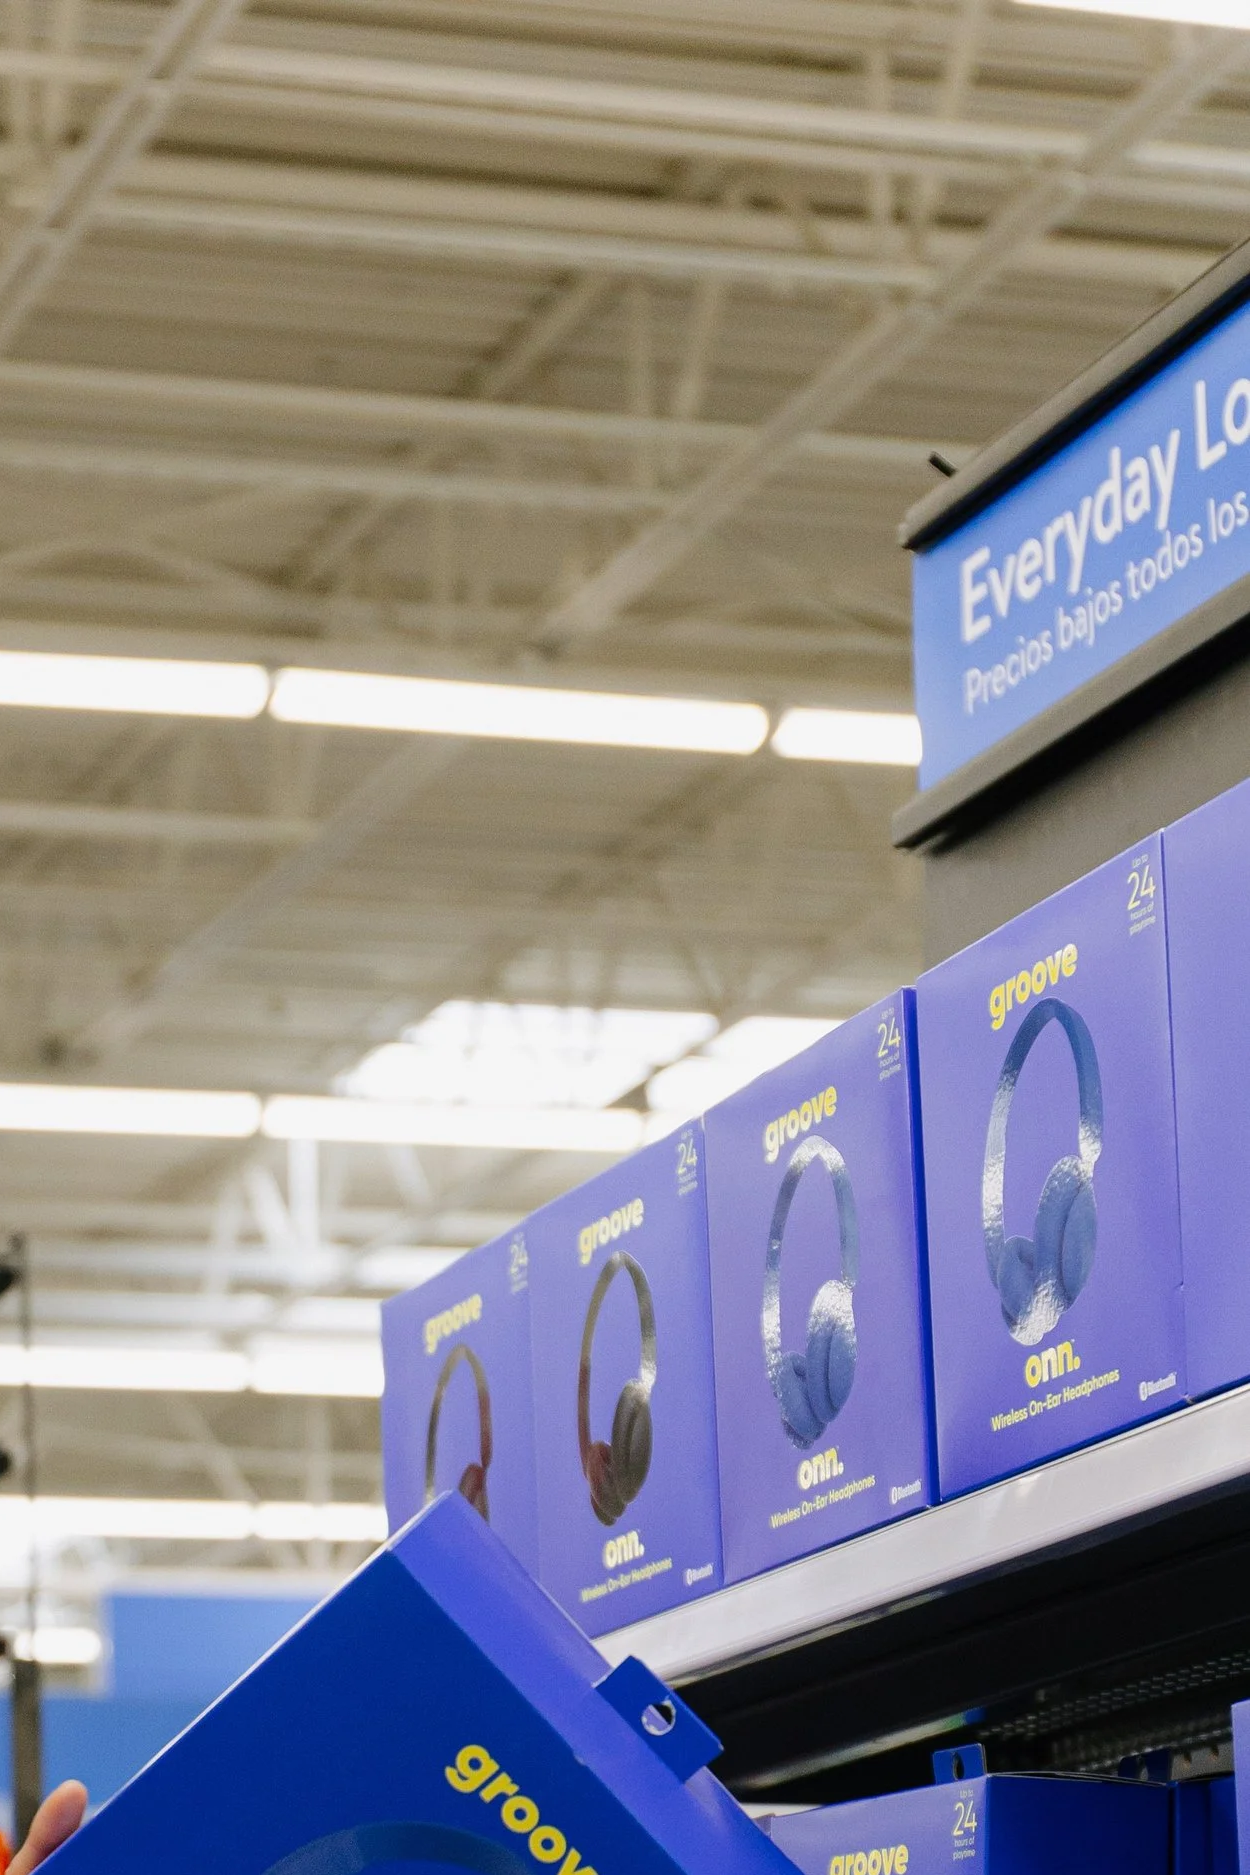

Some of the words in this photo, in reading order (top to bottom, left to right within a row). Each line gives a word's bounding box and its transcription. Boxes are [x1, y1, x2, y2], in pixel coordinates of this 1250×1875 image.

[960, 429, 1181, 644] Everyday
[1194, 377, 1250, 471] Lo
[963, 627, 1053, 714] Precios
[1057, 578, 1123, 647] bajos
[1126, 523, 1204, 599] todos
[1208, 490, 1250, 544] los
[1127, 865, 1156, 910] 24
[989, 943, 1079, 1031] groove
[877, 1017, 901, 1058] 24
[764, 1086, 838, 1163] groove
[677, 1138, 698, 1175] 24
[579, 1198, 645, 1265] groove
[425, 1293, 482, 1355] groove
[1025, 1340, 1081, 1388] onn.
[991, 1406, 1028, 1432] Wireless
[1029, 1393, 1062, 1416] On-Ear
[1063, 1369, 1120, 1402] Headphones
[798, 1447, 844, 1490] onn.
[604, 1530, 645, 1569] onn.
[953, 1800, 978, 1836] 24
